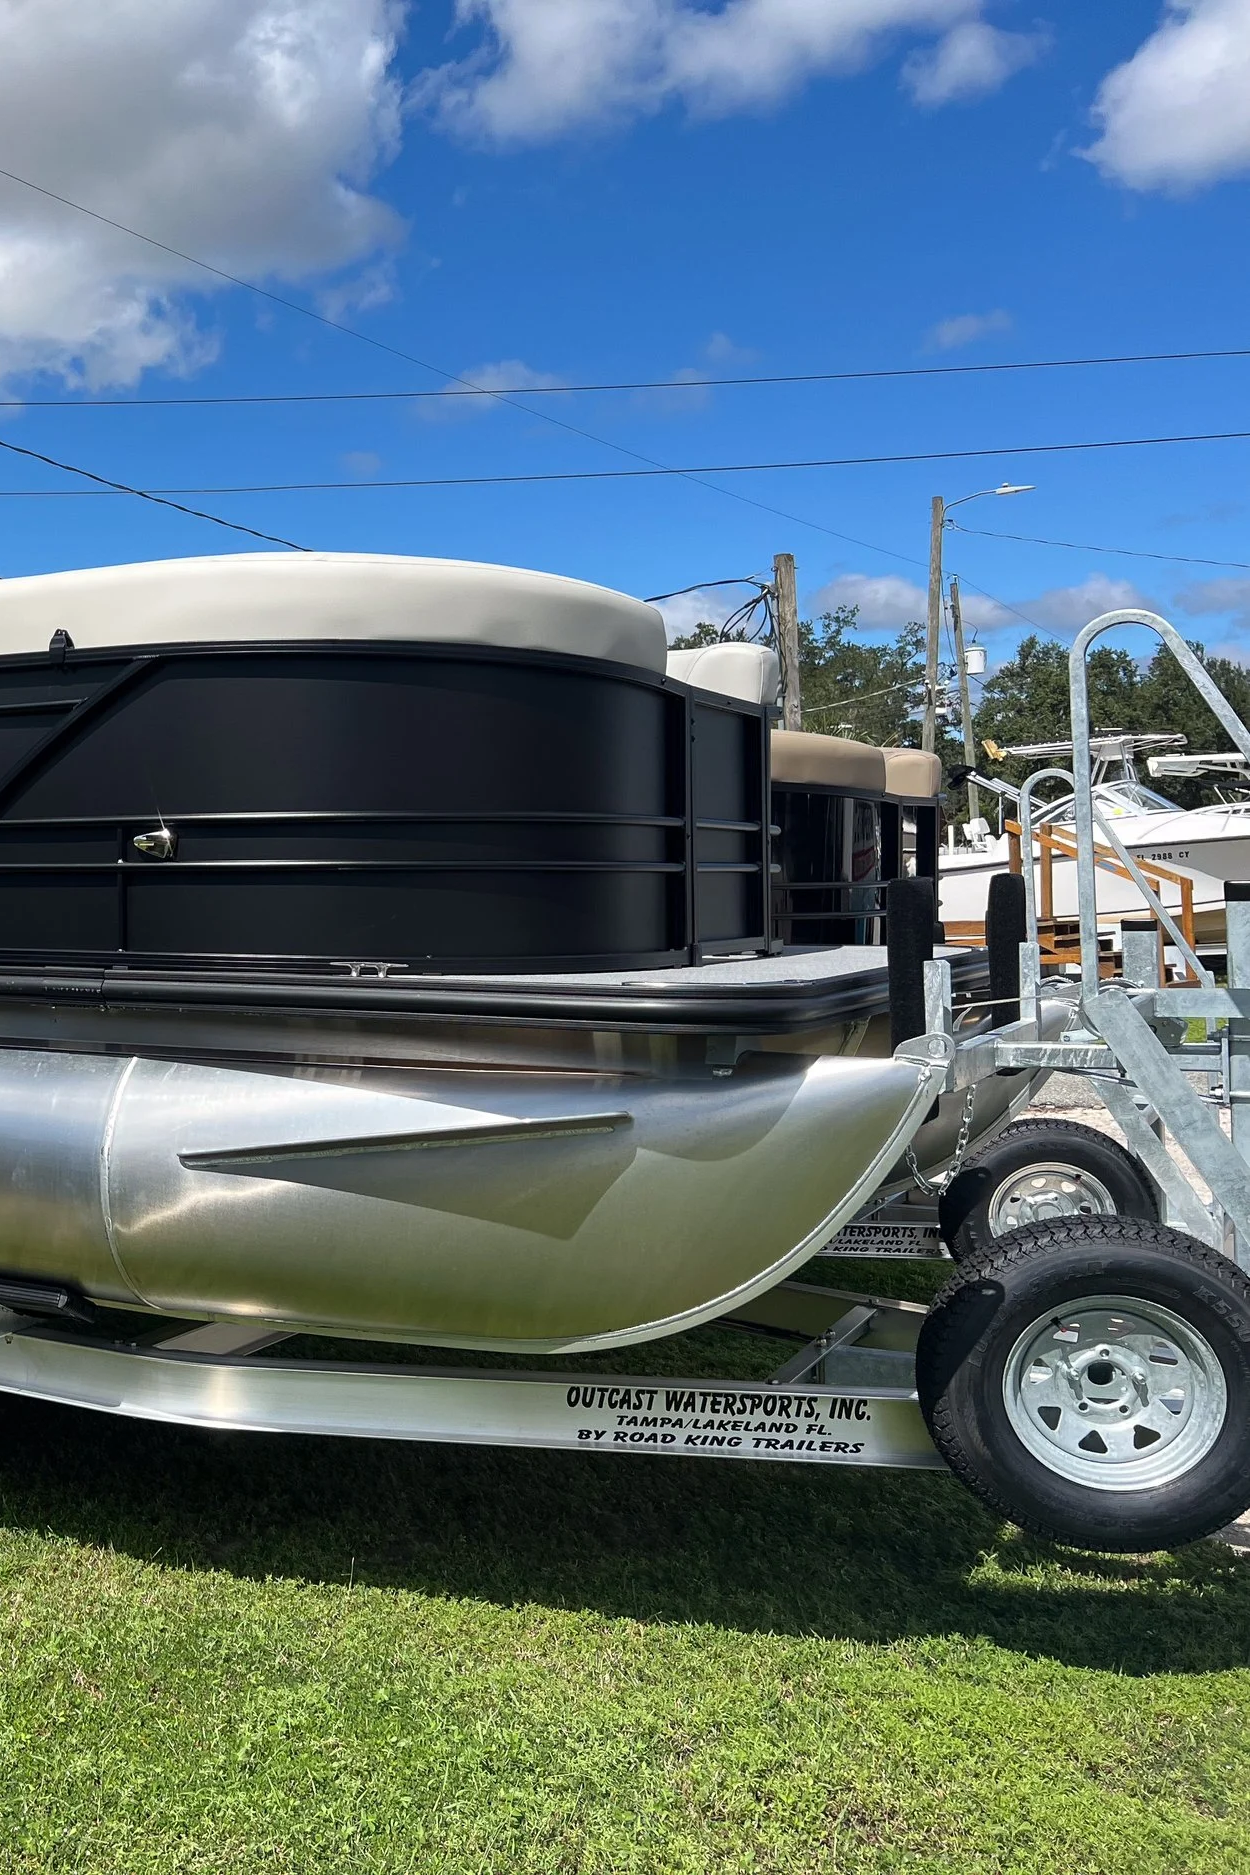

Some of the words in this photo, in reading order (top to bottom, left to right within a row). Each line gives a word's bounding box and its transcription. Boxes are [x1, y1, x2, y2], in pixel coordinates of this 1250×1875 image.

[566, 1386, 658, 1411] OUTCAST
[665, 1390, 821, 1422] WATERSPORTS,
[828, 1397, 871, 1421] INC.
[616, 1415, 799, 1434] TAMPA/LAKELAND
[805, 1423, 832, 1436] FL.
[577, 1429, 607, 1441] BY
[613, 1431, 677, 1444] ROAD
[683, 1434, 743, 1447] KING
[751, 1437, 865, 1454] TRAILERS
